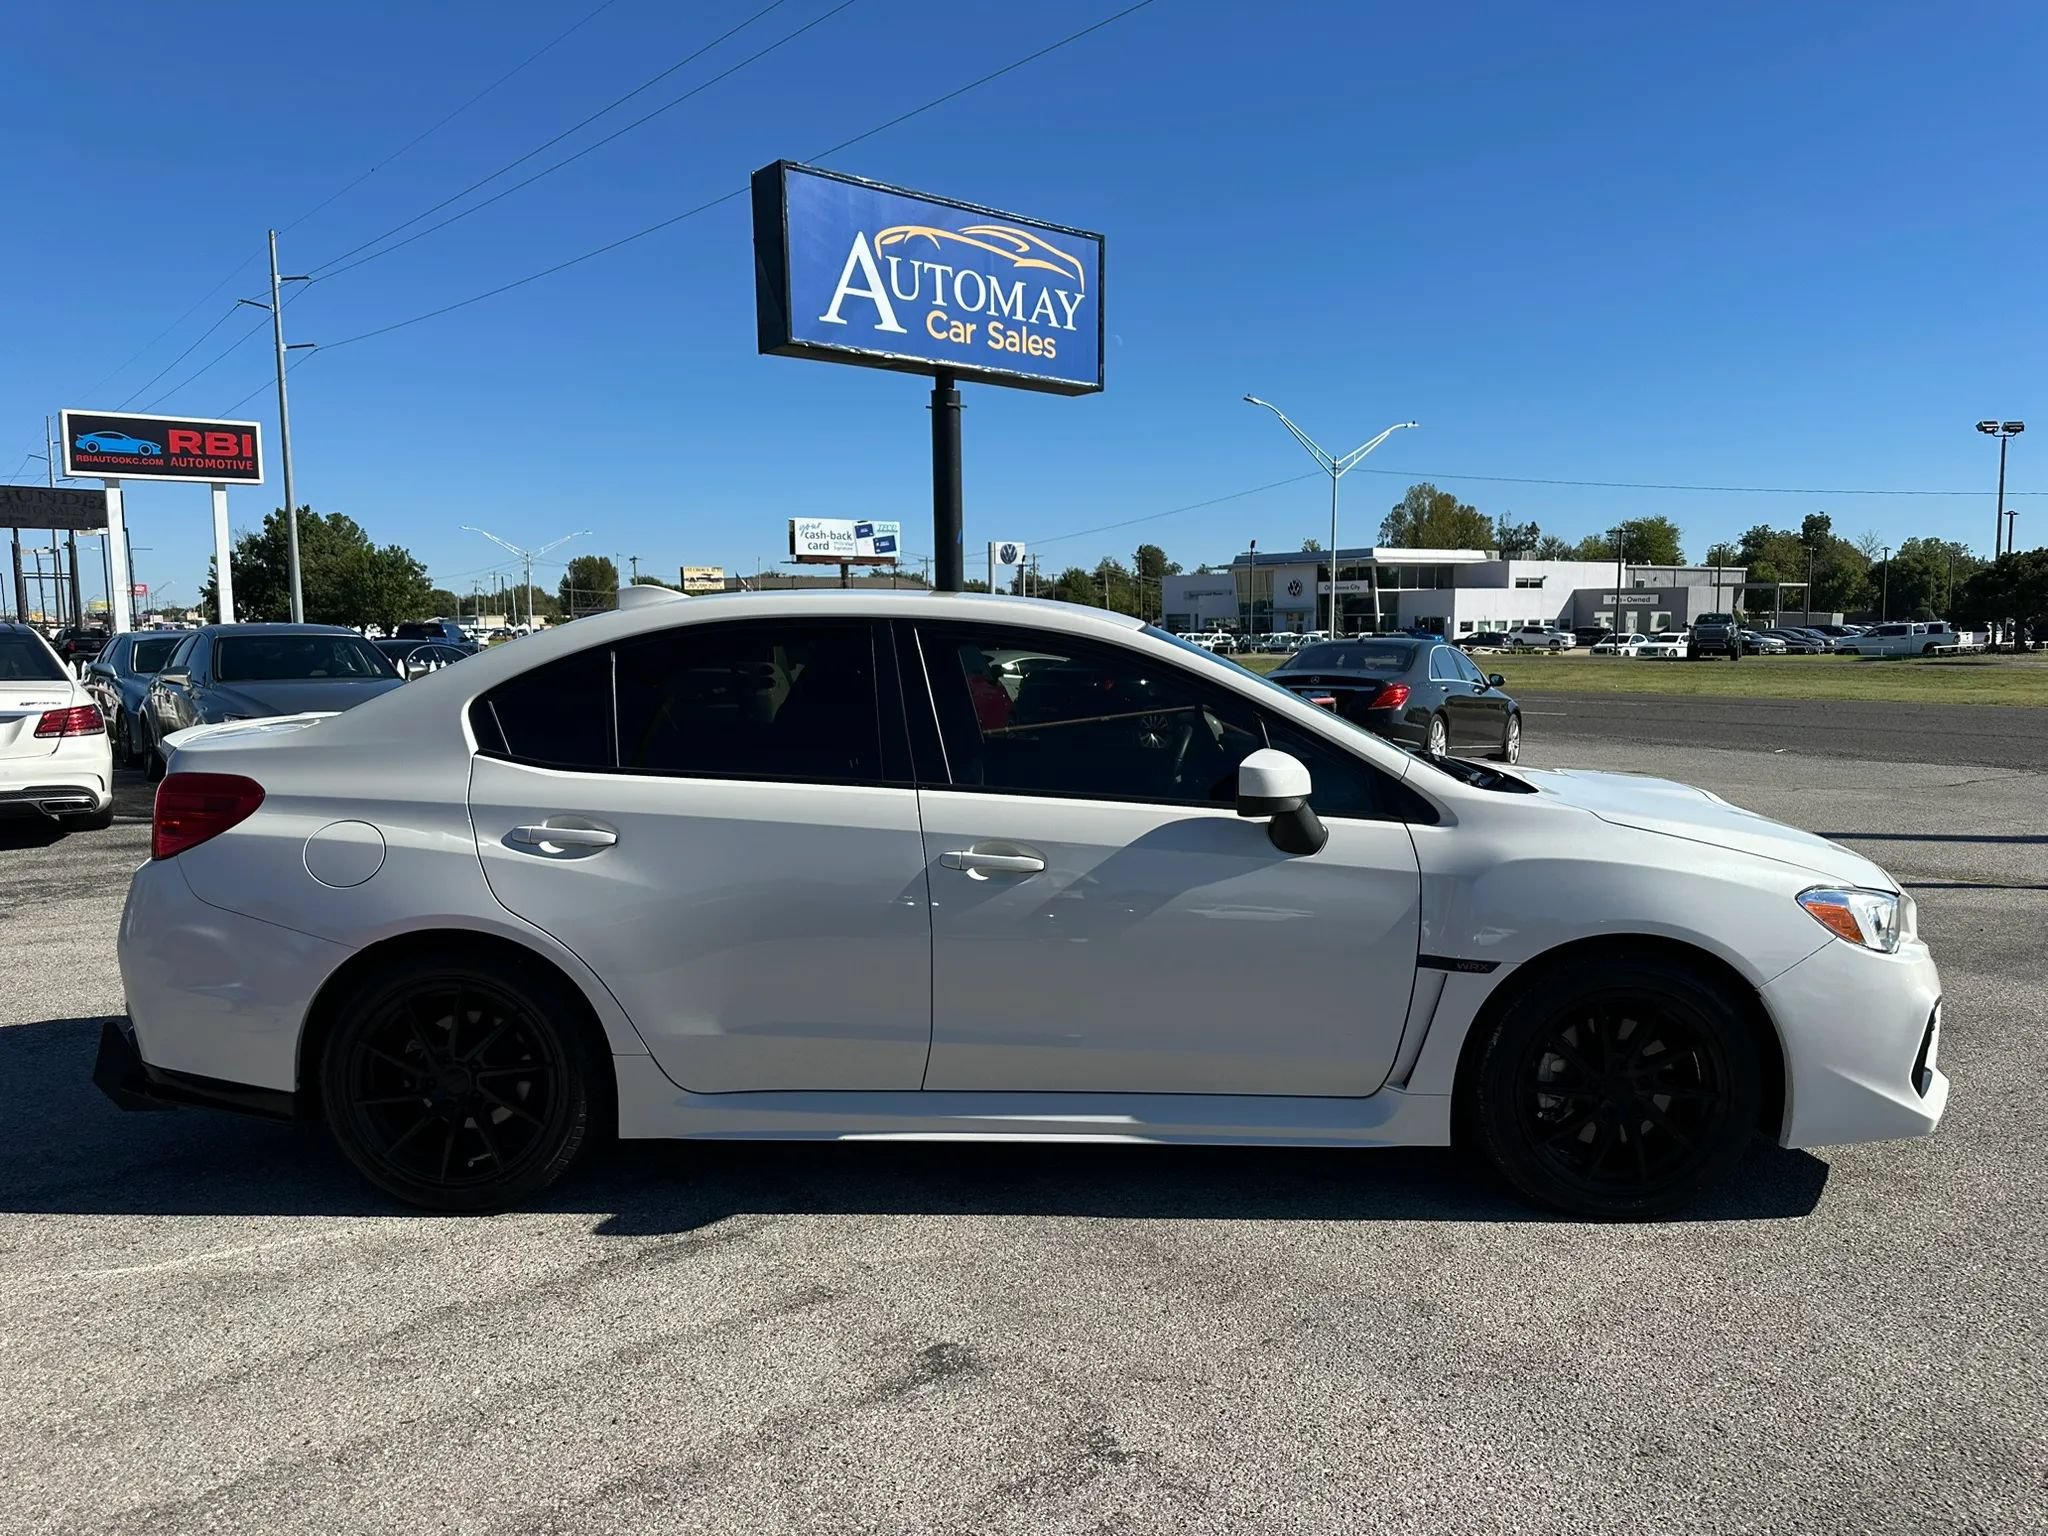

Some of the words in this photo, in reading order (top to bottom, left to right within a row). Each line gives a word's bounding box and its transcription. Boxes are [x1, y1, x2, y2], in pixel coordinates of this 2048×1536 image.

[818, 231, 1086, 333] AUTOMAY
[926, 309, 977, 345] Car
[987, 320, 1057, 360] Sales
[168, 429, 253, 458] RBI
[76, 455, 164, 466] RBIAUTOOKC.COM
[170, 457, 253, 471] AUTOMOTIVE
[799, 522, 822, 537] your
[804, 530, 852, 541] cash-back
[807, 541, 830, 550] card
[1350, 583, 1360, 591] City
[1456, 961, 1489, 971] WRX
